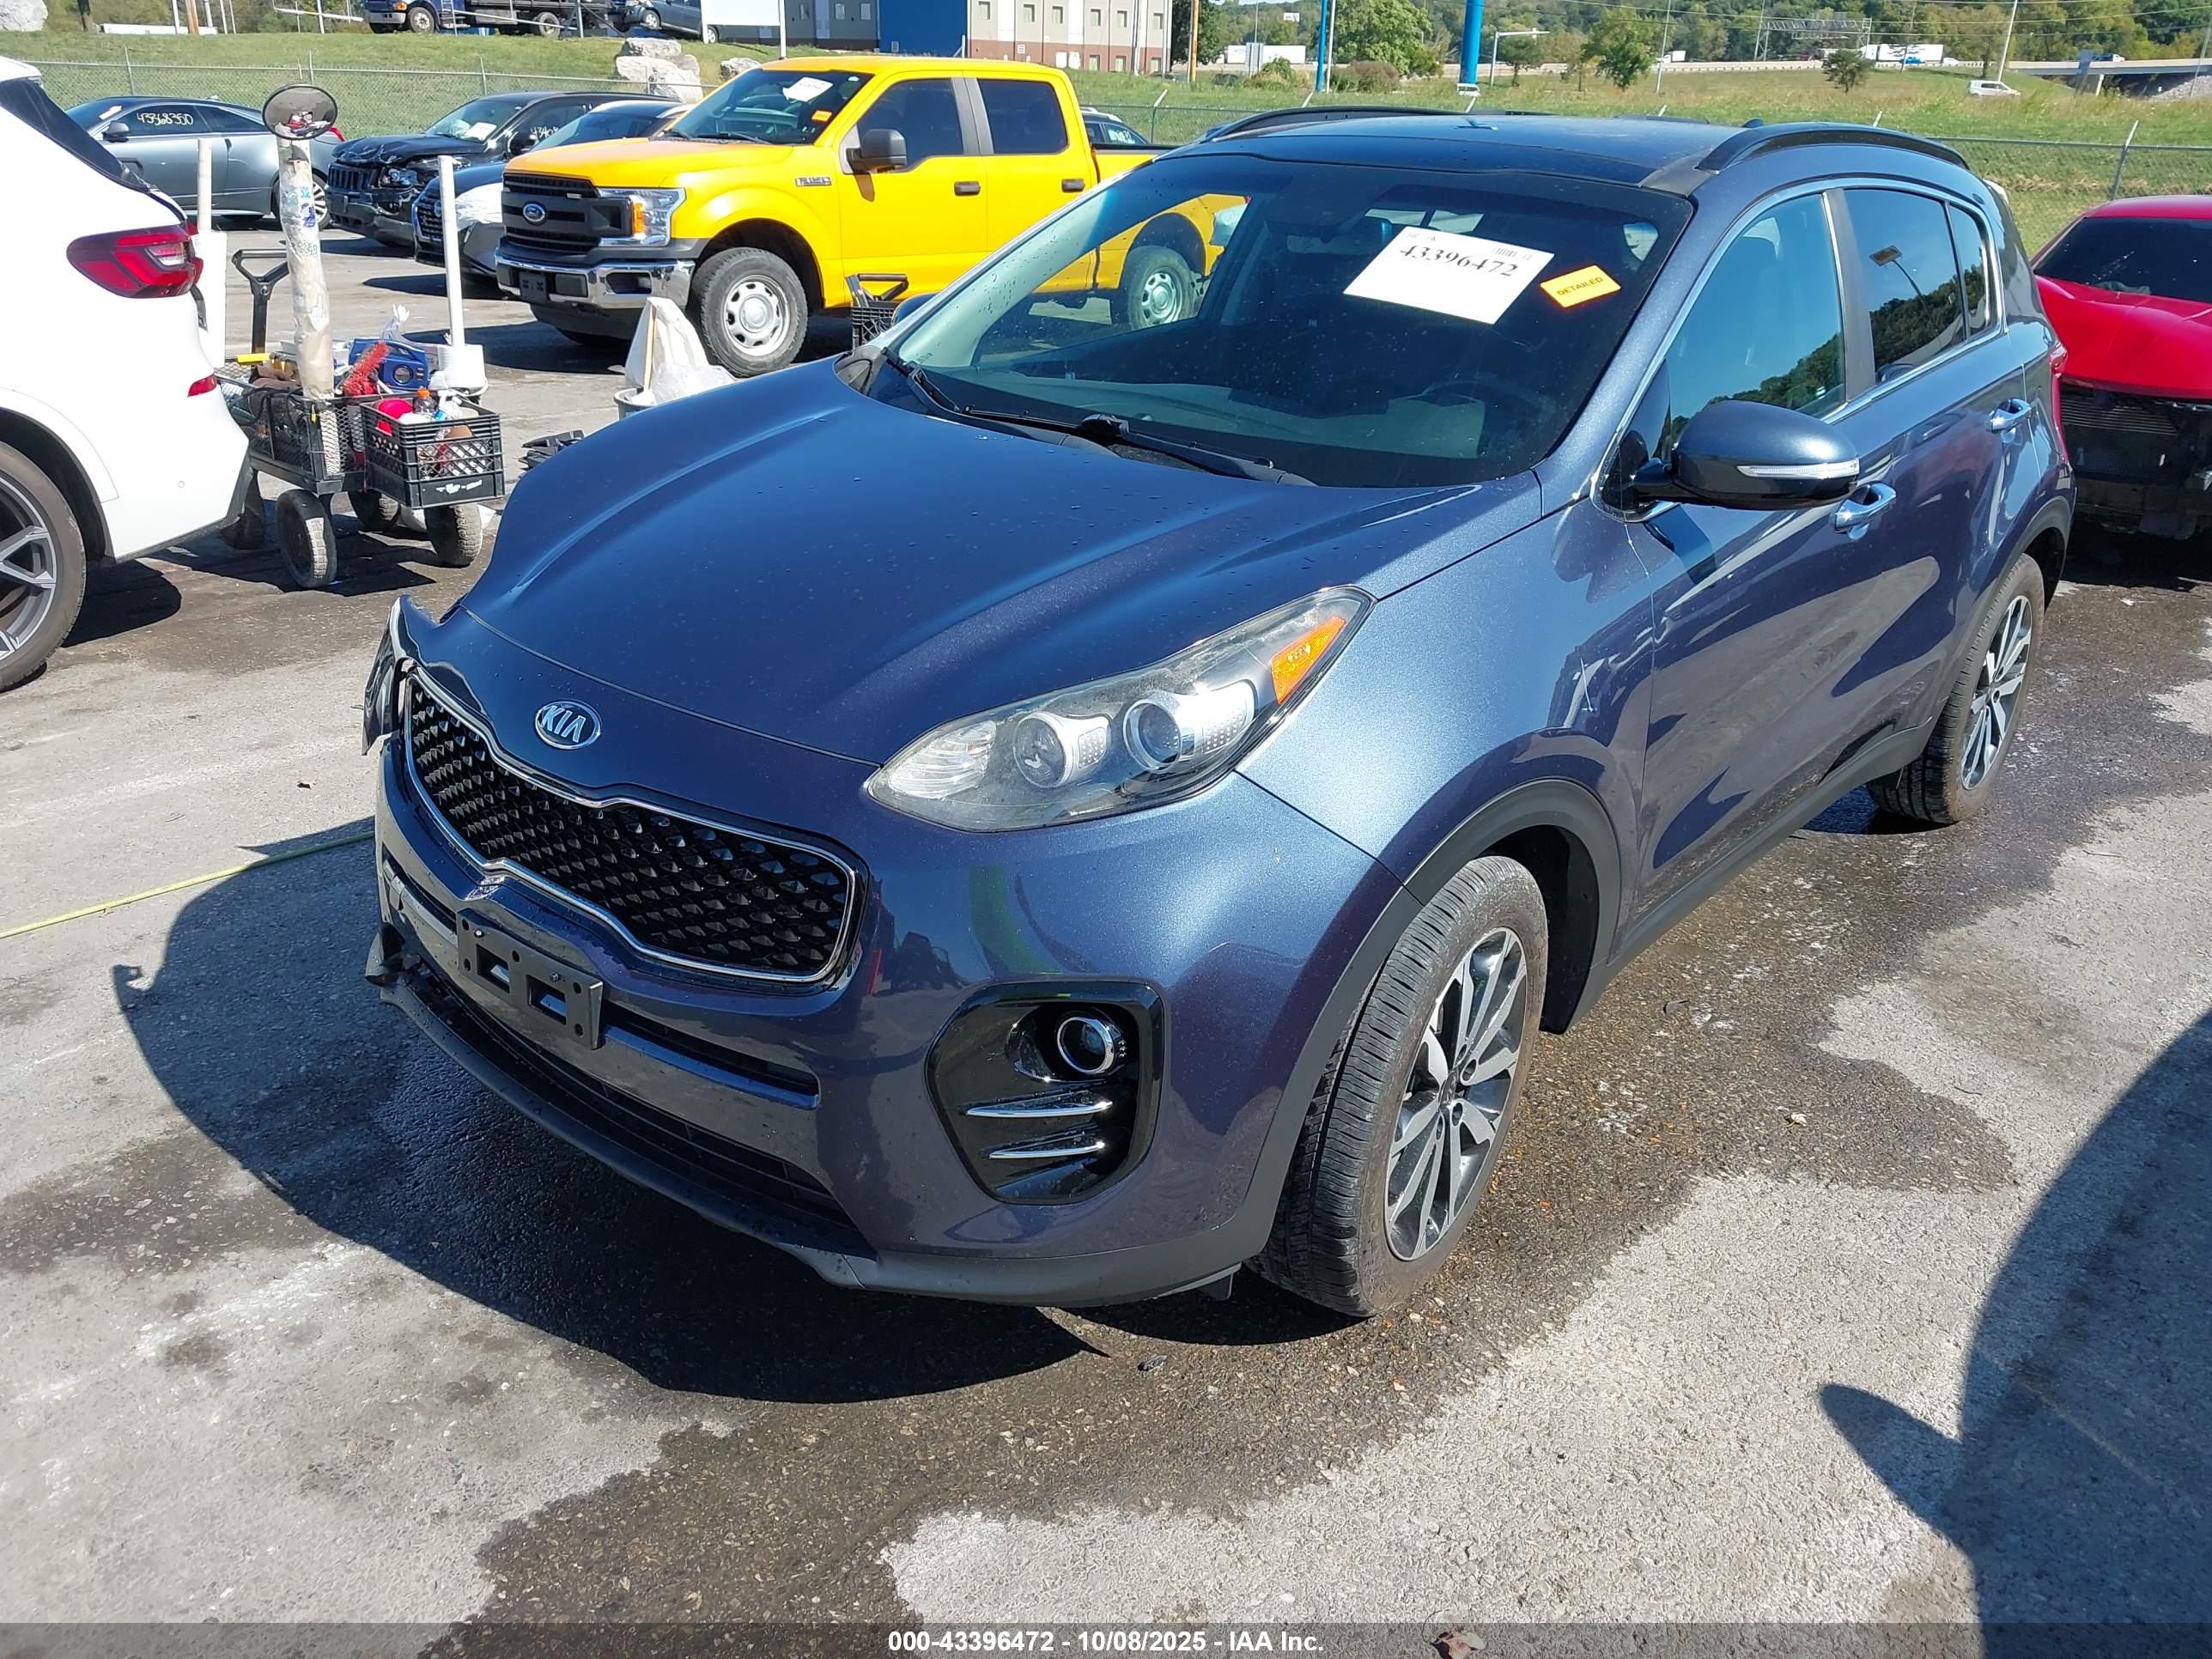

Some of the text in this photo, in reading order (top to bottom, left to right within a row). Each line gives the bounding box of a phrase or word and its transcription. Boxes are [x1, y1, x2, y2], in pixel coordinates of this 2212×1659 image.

[1400, 245, 1518, 276] 43396472
[1557, 276, 1603, 295] DETAILED
[542, 704, 586, 744] KIA
